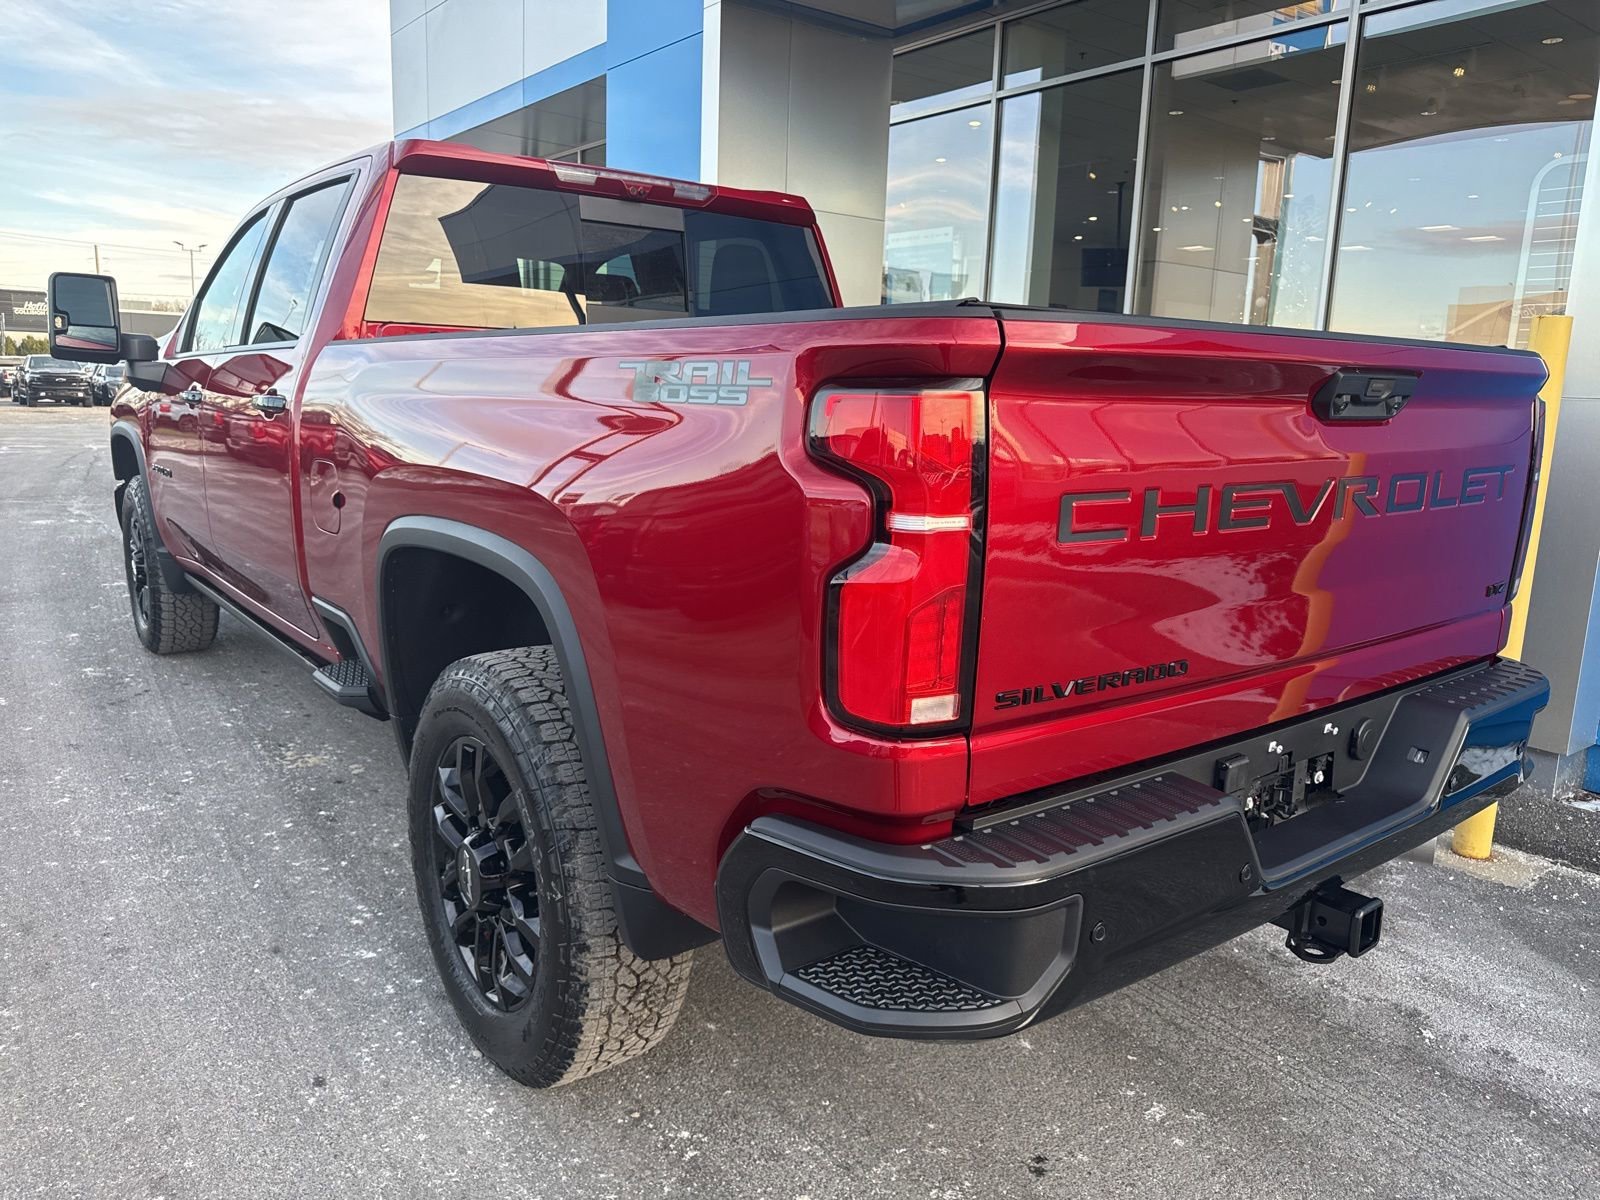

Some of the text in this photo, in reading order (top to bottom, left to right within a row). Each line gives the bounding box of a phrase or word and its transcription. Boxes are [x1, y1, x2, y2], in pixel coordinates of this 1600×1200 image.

[619, 360, 773, 387] TRAIL
[633, 383, 749, 406] BOSS
[1056, 464, 1515, 547] CHEVROLET
[994, 659, 1189, 710] SILVERADO
